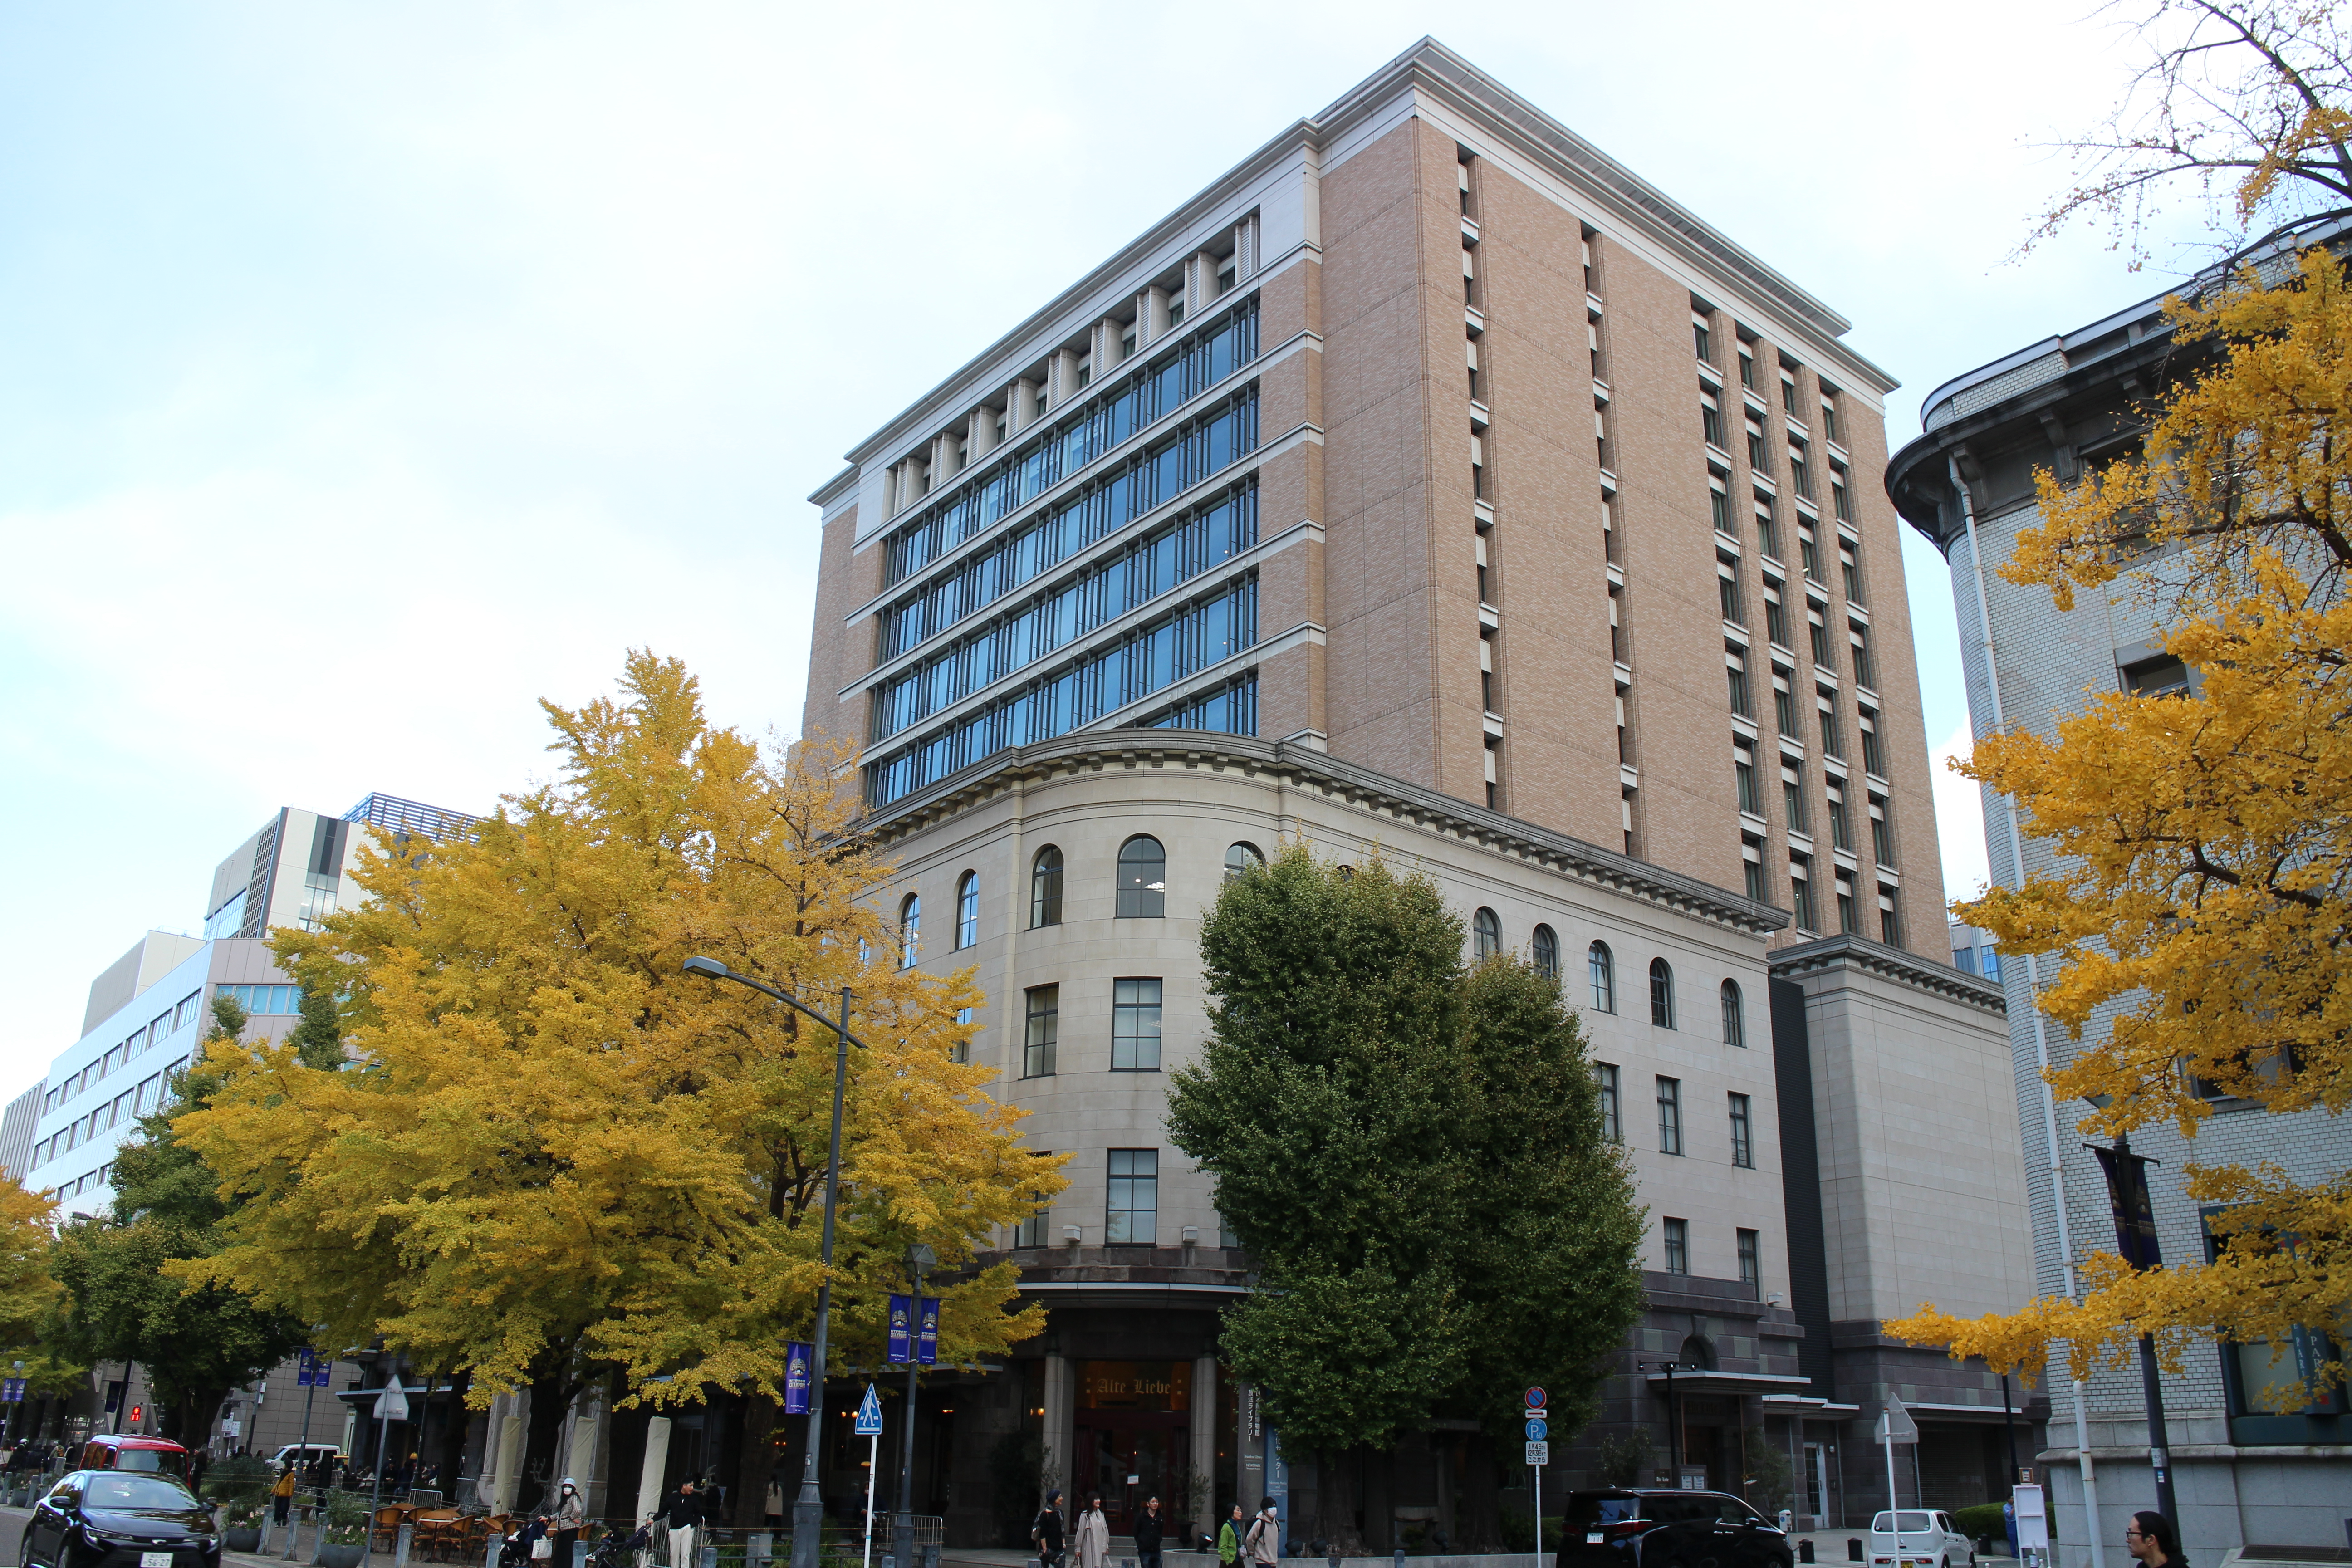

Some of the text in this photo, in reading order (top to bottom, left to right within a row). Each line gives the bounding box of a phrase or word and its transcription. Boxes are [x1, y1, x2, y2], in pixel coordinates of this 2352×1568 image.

[1097, 1378, 1171, 1394] Alte Liebe
[1530, 1425, 1539, 1439] P
